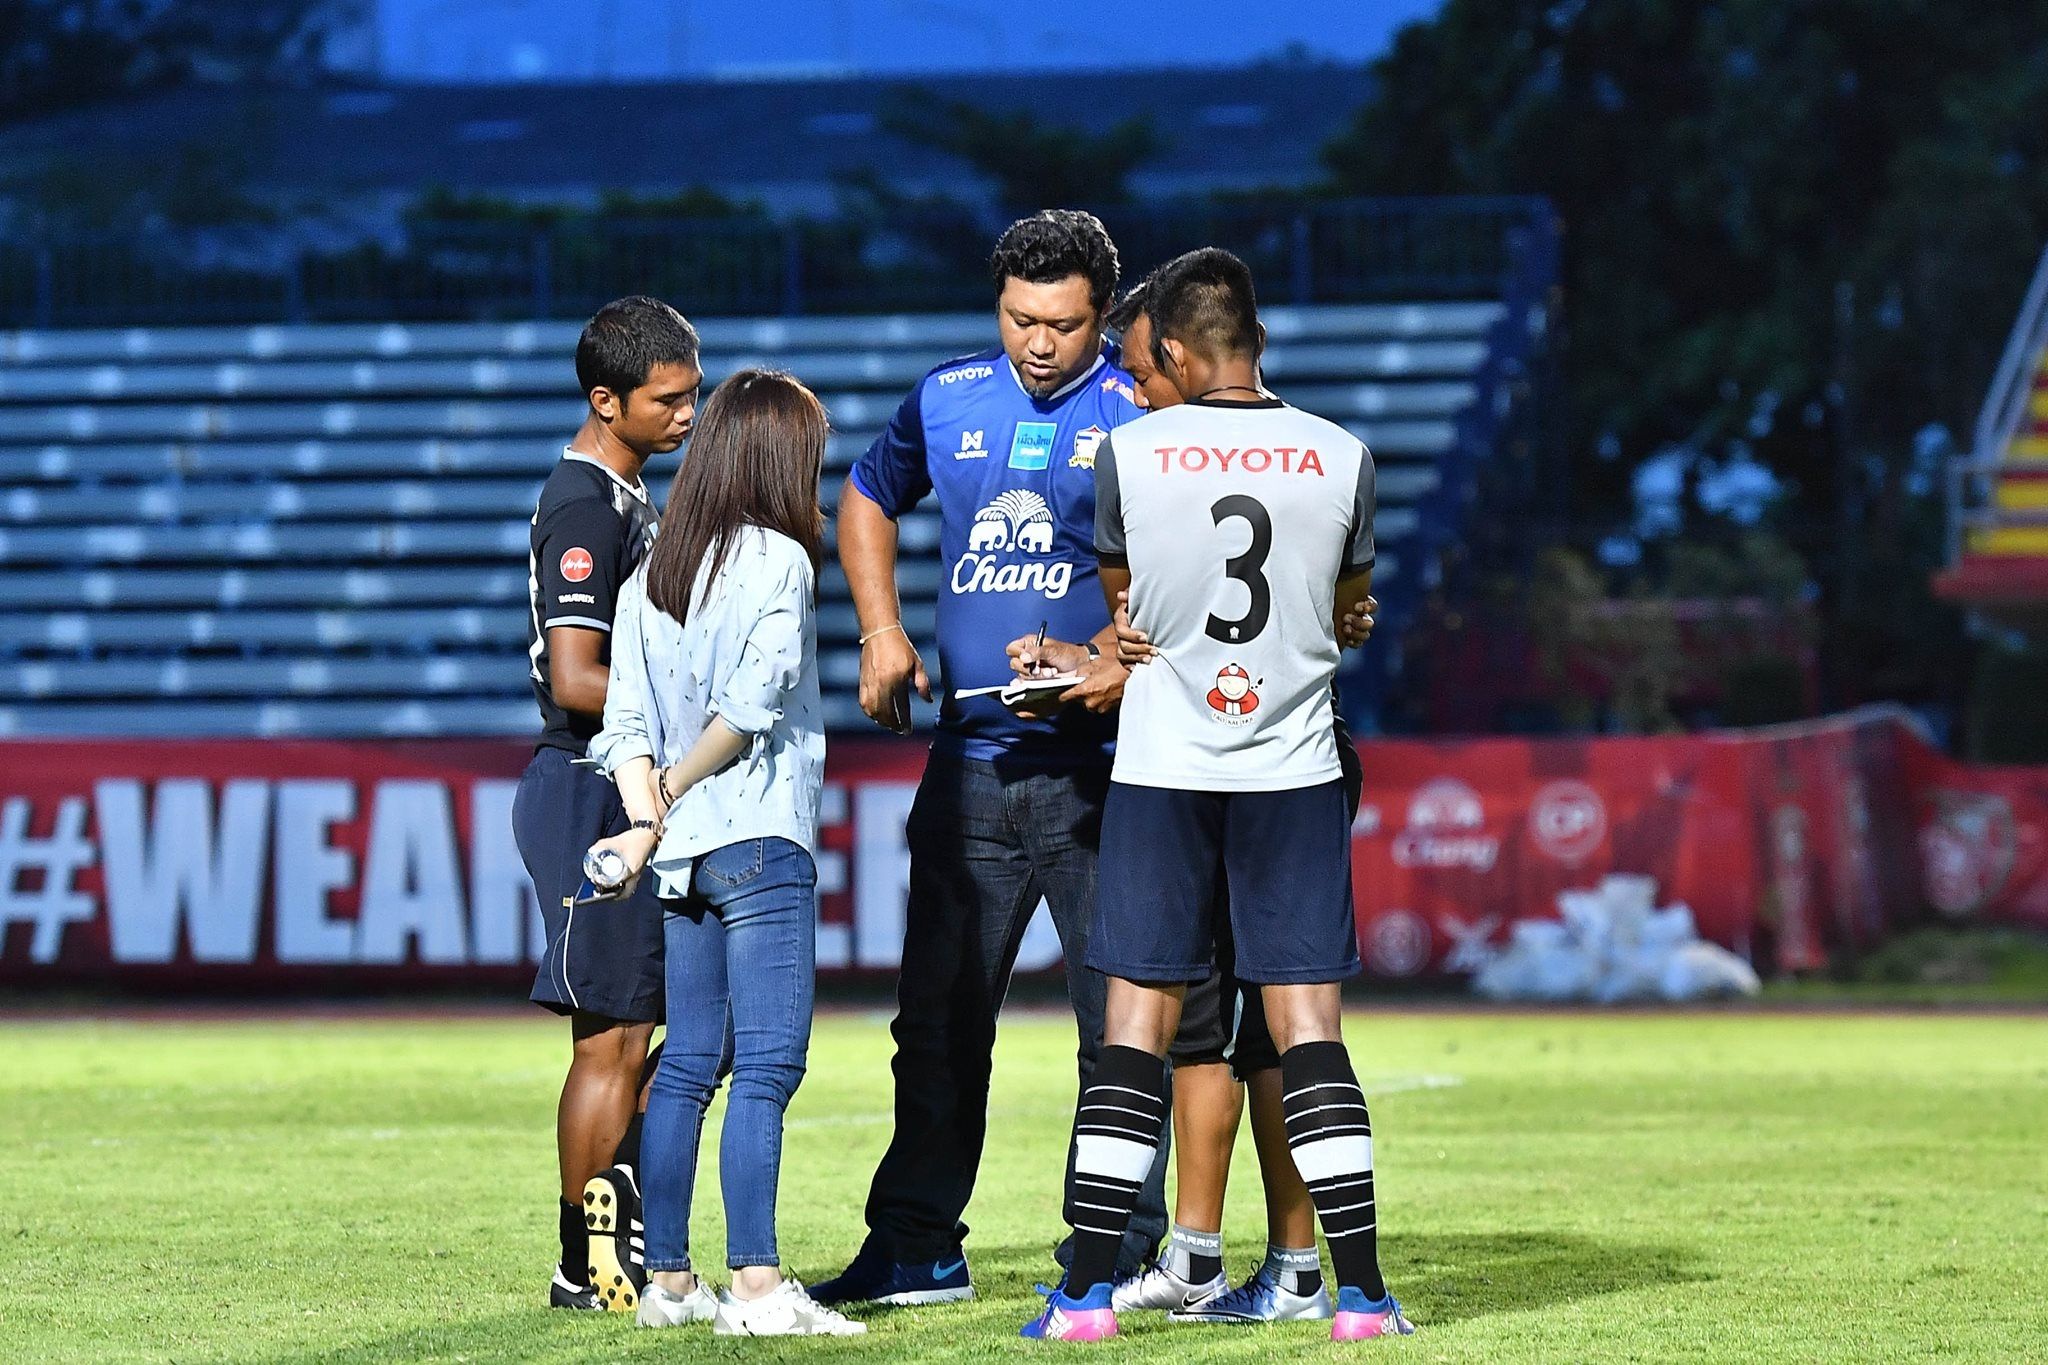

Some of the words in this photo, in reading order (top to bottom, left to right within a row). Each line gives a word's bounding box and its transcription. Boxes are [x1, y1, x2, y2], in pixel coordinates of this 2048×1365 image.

[938, 366, 994, 386] TOYOTA
[1154, 446, 1325, 476] TOYOTA
[951, 552, 1074, 600] Chang
[1204, 494, 1273, 645] 3
